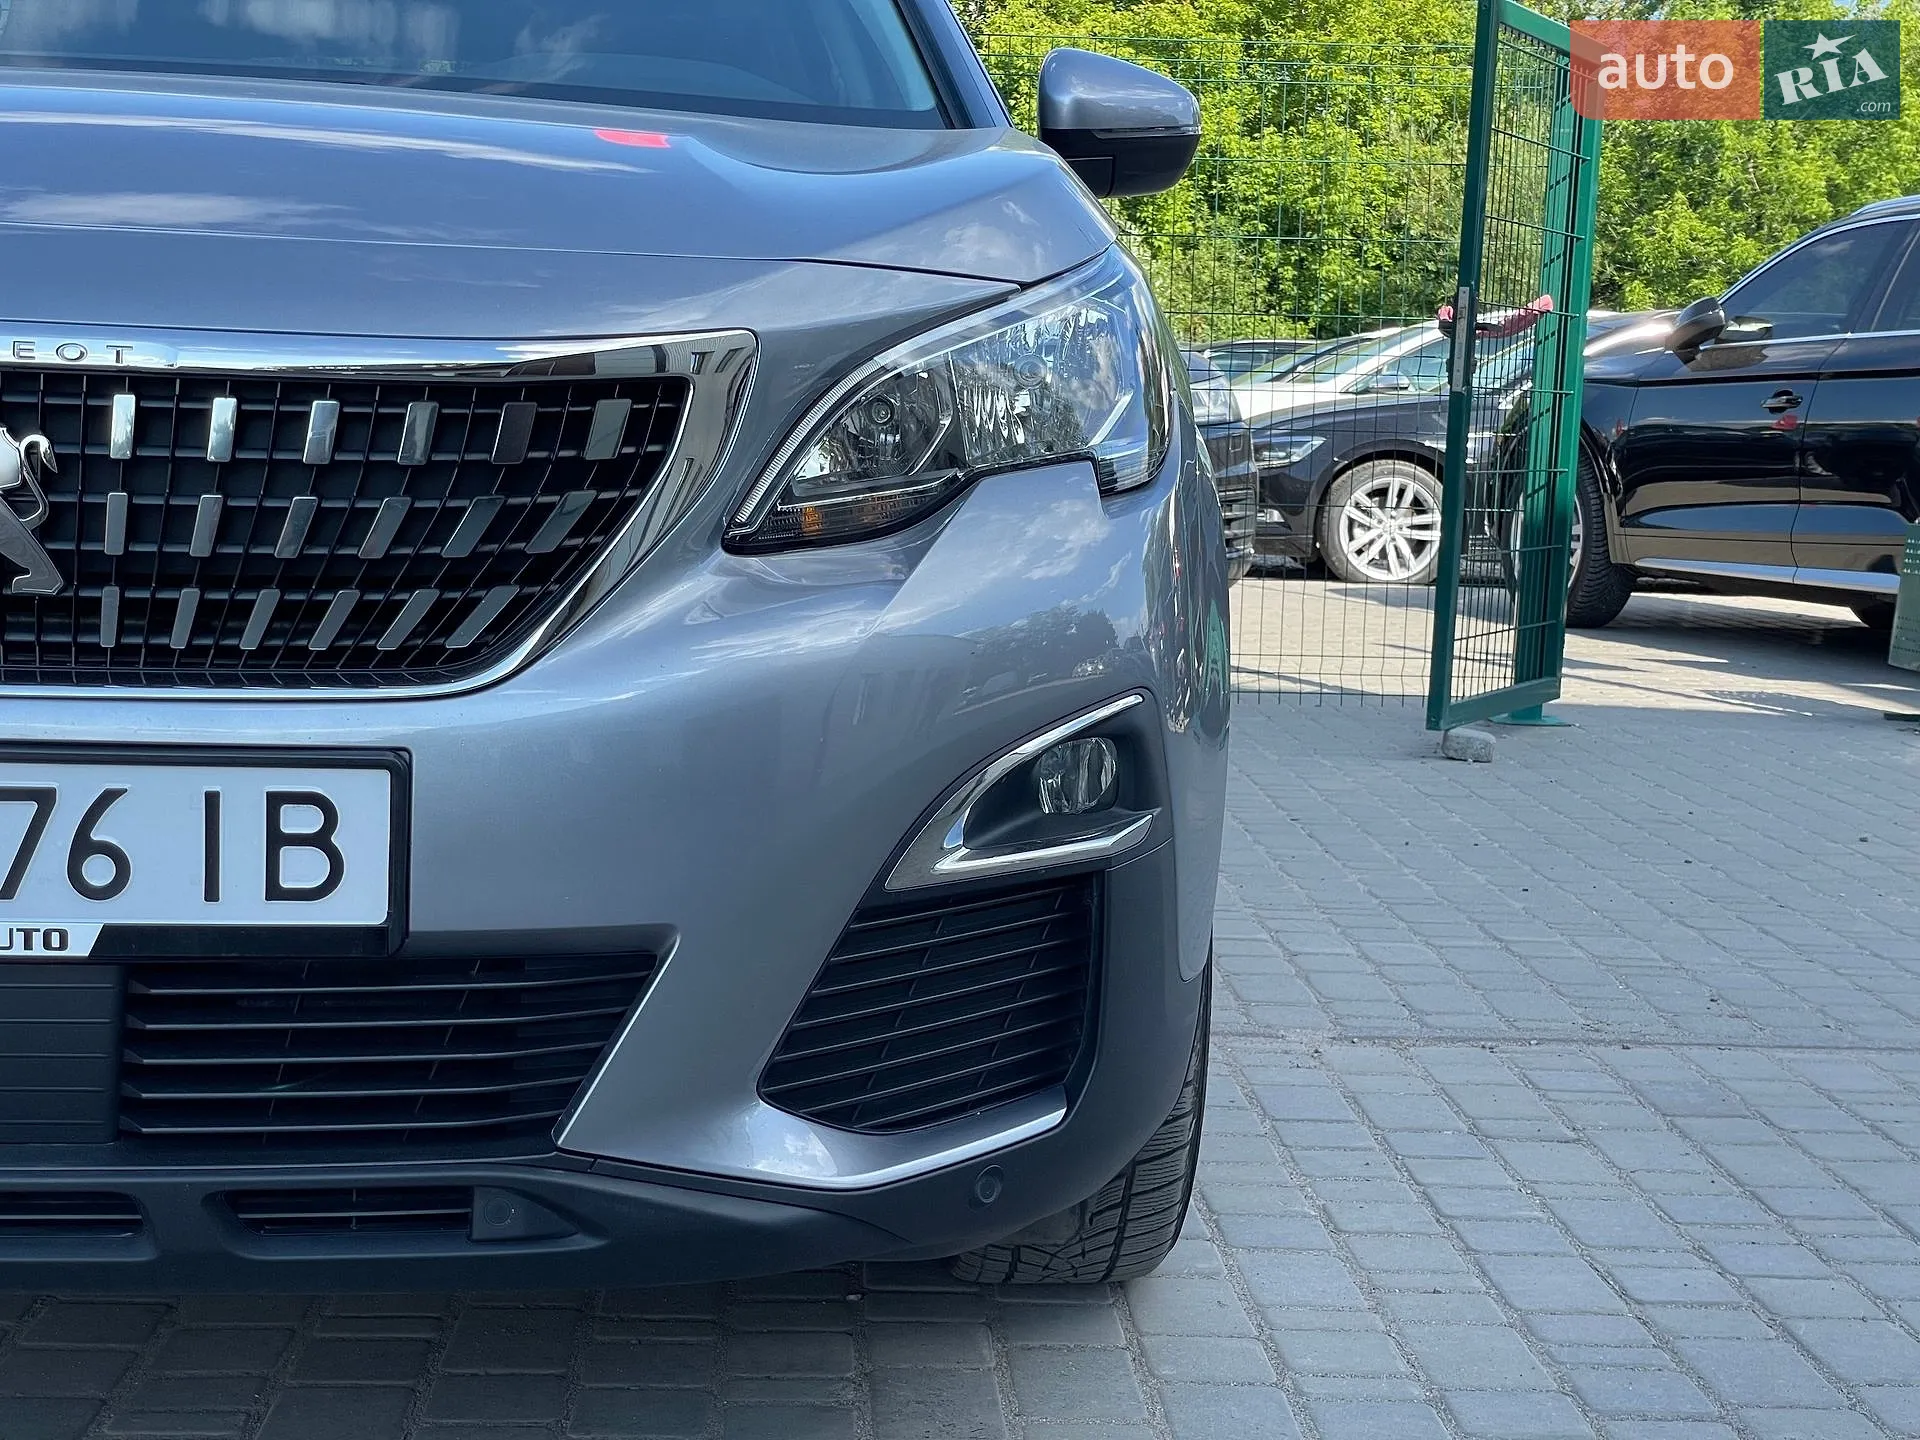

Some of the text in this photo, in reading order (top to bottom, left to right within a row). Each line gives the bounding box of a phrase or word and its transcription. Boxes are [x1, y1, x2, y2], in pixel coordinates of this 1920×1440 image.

[13, 340, 134, 364] EOT
[0, 786, 345, 903] 76 IB
